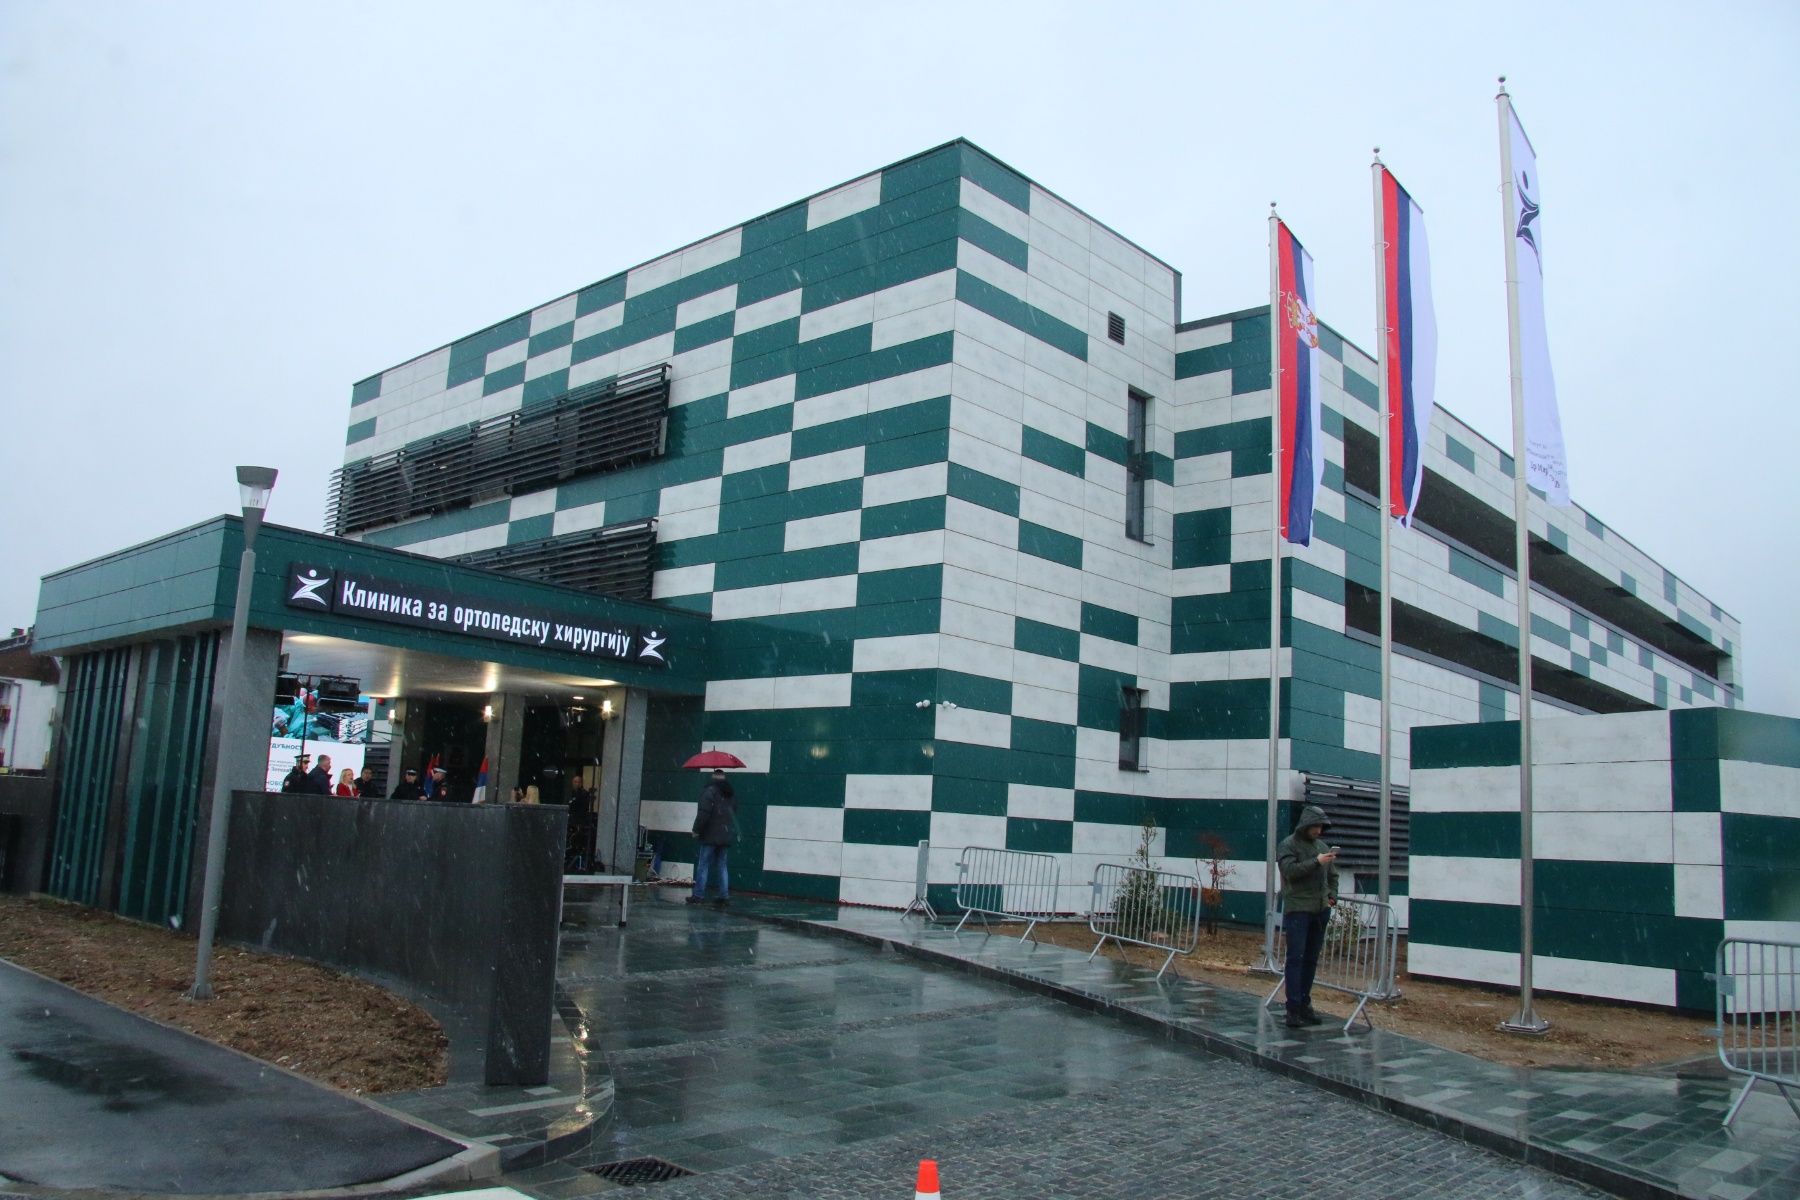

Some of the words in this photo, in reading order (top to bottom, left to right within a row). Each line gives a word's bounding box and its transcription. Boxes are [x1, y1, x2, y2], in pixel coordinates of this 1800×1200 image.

[342, 580, 423, 617] Клиника
[428, 602, 448, 622] за
[453, 605, 550, 644] ортопедску
[554, 623, 630, 657] хирургију
